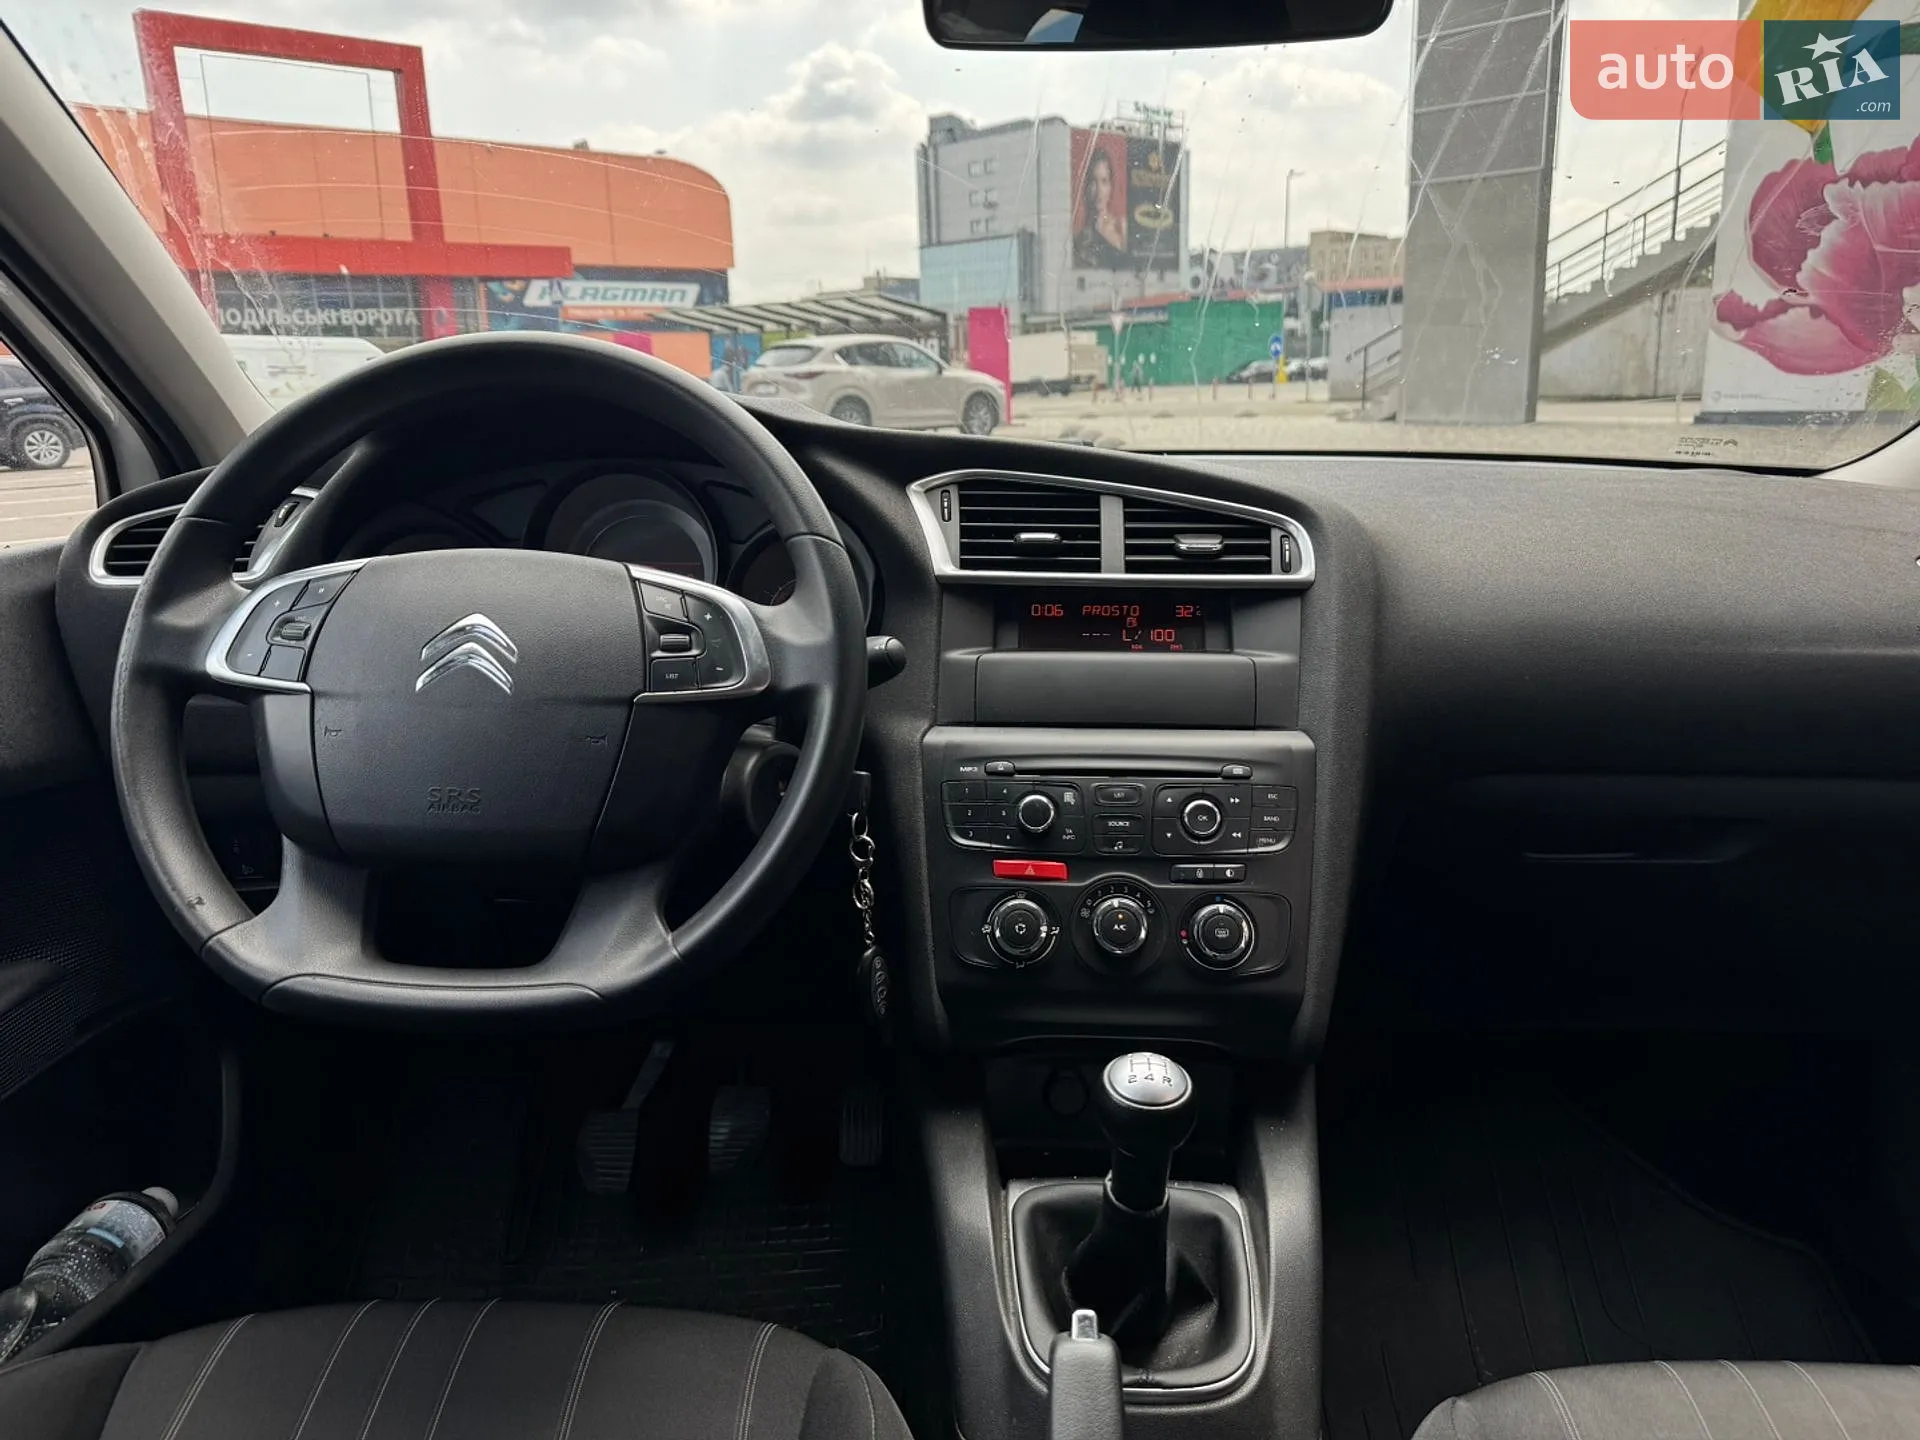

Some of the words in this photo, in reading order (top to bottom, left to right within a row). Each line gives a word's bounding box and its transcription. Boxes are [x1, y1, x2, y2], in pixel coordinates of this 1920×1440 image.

[1031, 604, 1064, 617] 0:06
[1082, 604, 1140, 617] PROSTO
[426, 786, 481, 803] SRS
[1197, 814, 1209, 822] OK
[1128, 1074, 1137, 1083] 2
[1144, 1073, 1154, 1081] 4
[1162, 1075, 1173, 1087] R
